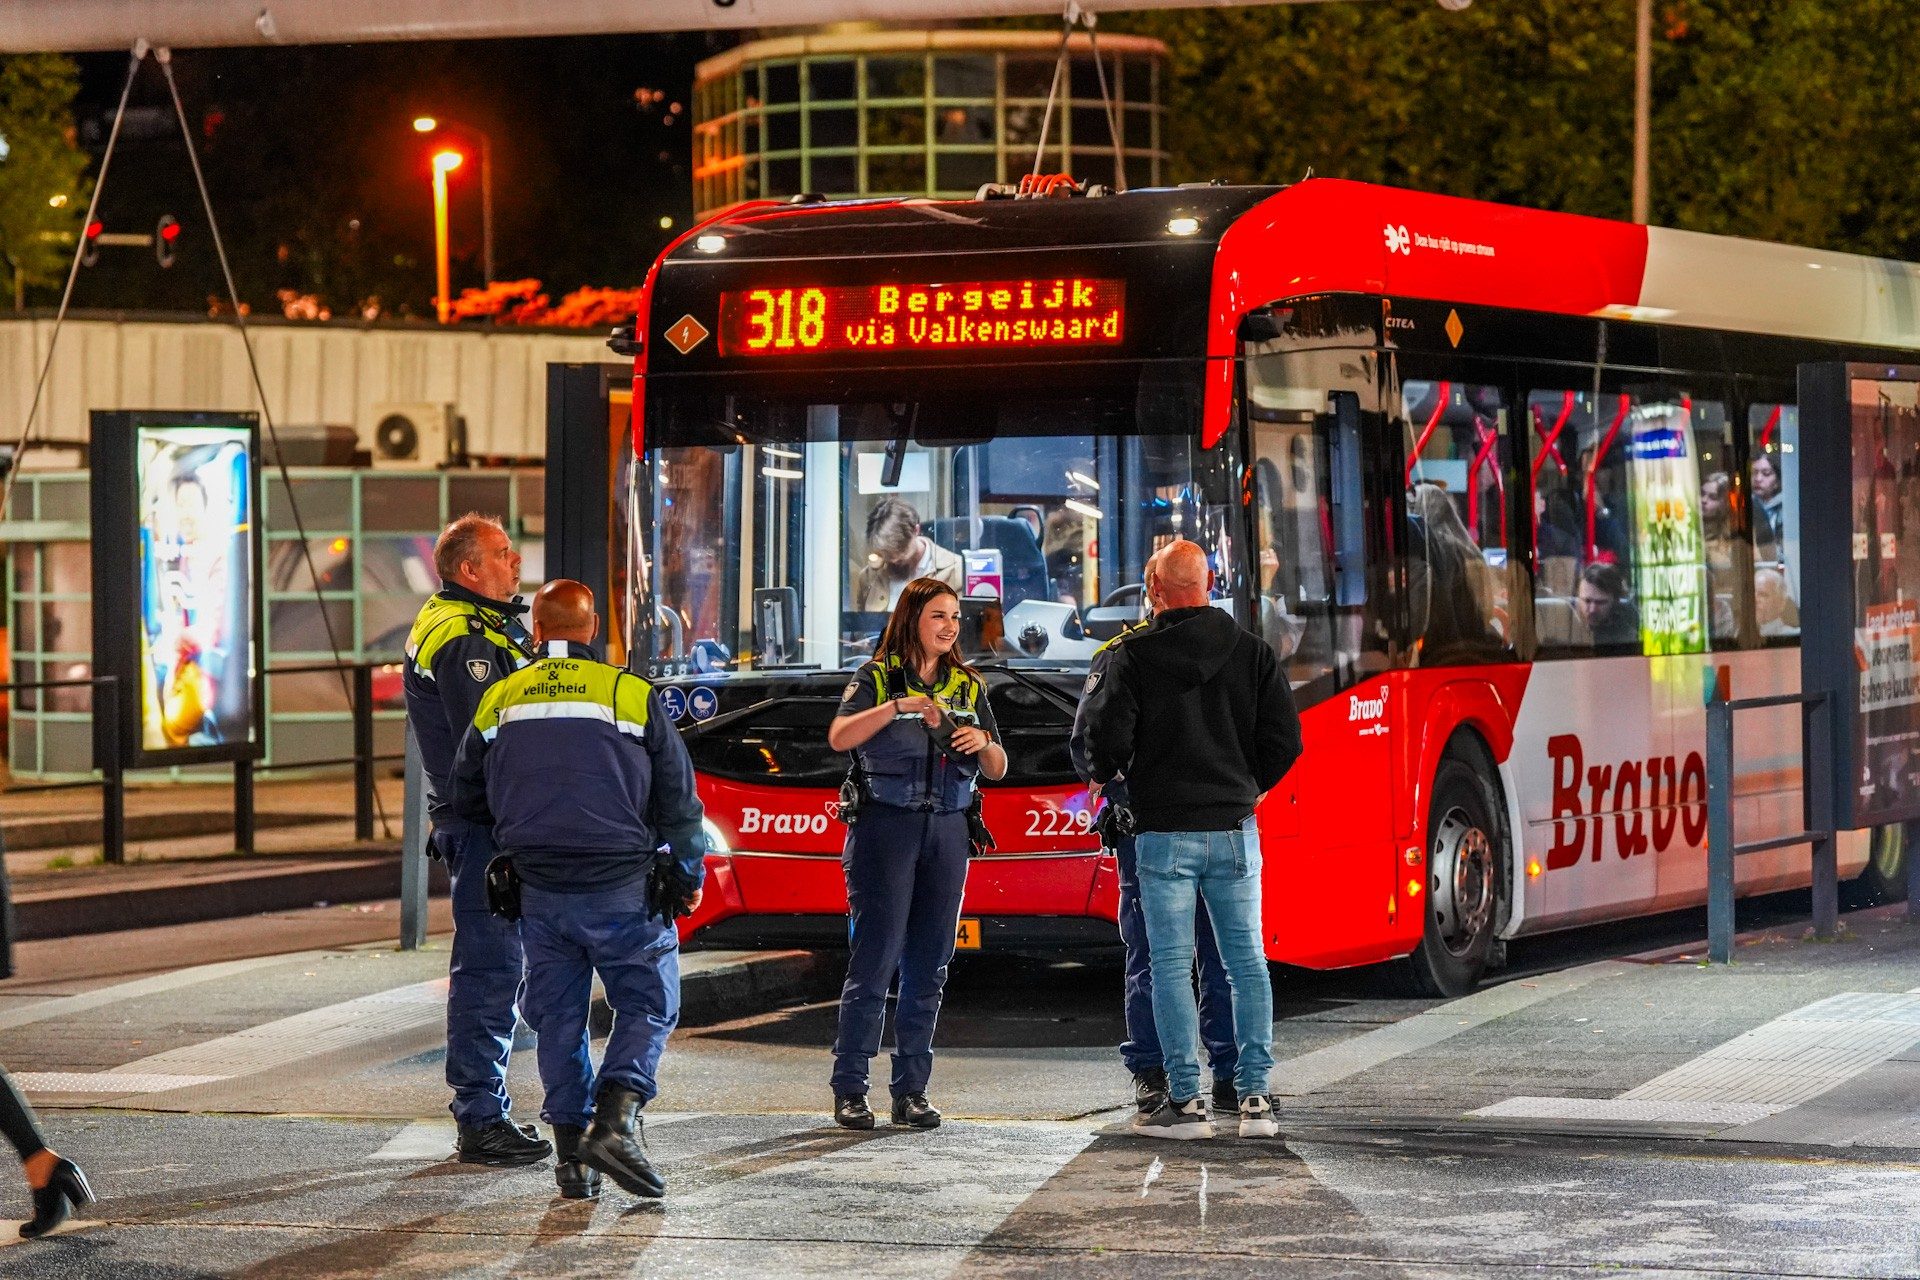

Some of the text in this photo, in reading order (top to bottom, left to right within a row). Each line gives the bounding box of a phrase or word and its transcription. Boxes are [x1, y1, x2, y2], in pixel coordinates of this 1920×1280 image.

[878, 278, 1094, 315] Bergeijk
[746, 288, 827, 349] 318
[846, 310, 1119, 347] via Valkenswaard
[1385, 316, 1415, 330] CITEA
[523, 682, 587, 697] Veiligheid
[547, 670, 560, 681] &
[1348, 694, 1384, 721] Bravo
[1546, 732, 1708, 873] Bravo
[738, 806, 829, 837] Bravo
[1024, 808, 1093, 837] 2229
